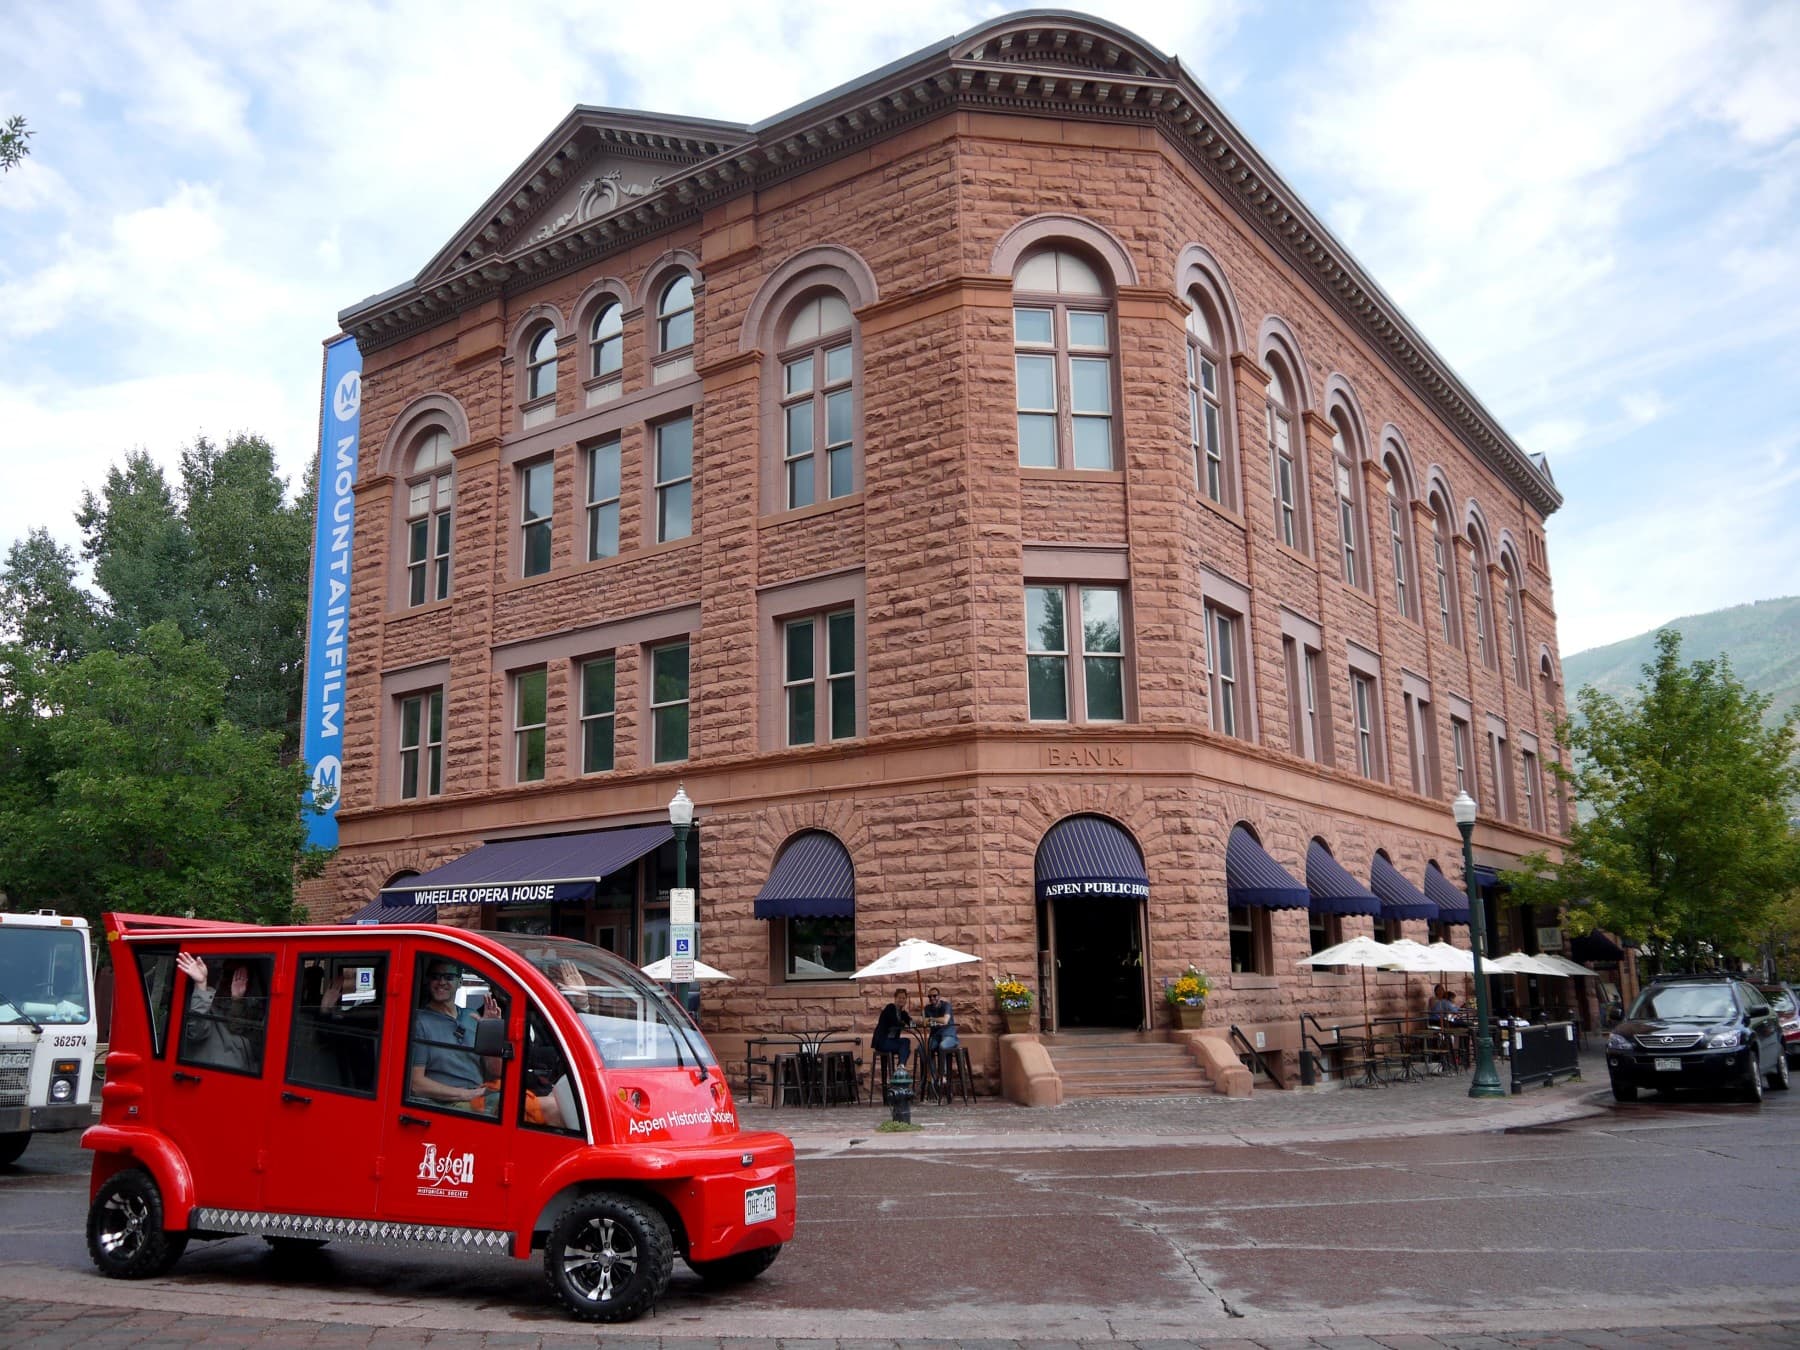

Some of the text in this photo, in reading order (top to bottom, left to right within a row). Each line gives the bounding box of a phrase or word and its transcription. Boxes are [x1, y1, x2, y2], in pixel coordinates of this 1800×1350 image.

[320, 434, 355, 738] MOUNTAINFILM
[1047, 747, 1124, 766] BANK
[414, 885, 555, 905] WHEELER OPERA HOUSE
[1046, 883, 1081, 897] ASPEN
[1084, 882, 1131, 894] PUBLIC
[53, 1035, 88, 1047] 362574
[629, 1107, 735, 1136] Aspen Historical Society
[416, 1142, 475, 1187] Aspen
[447, 1190, 468, 1198] SOCIETY
